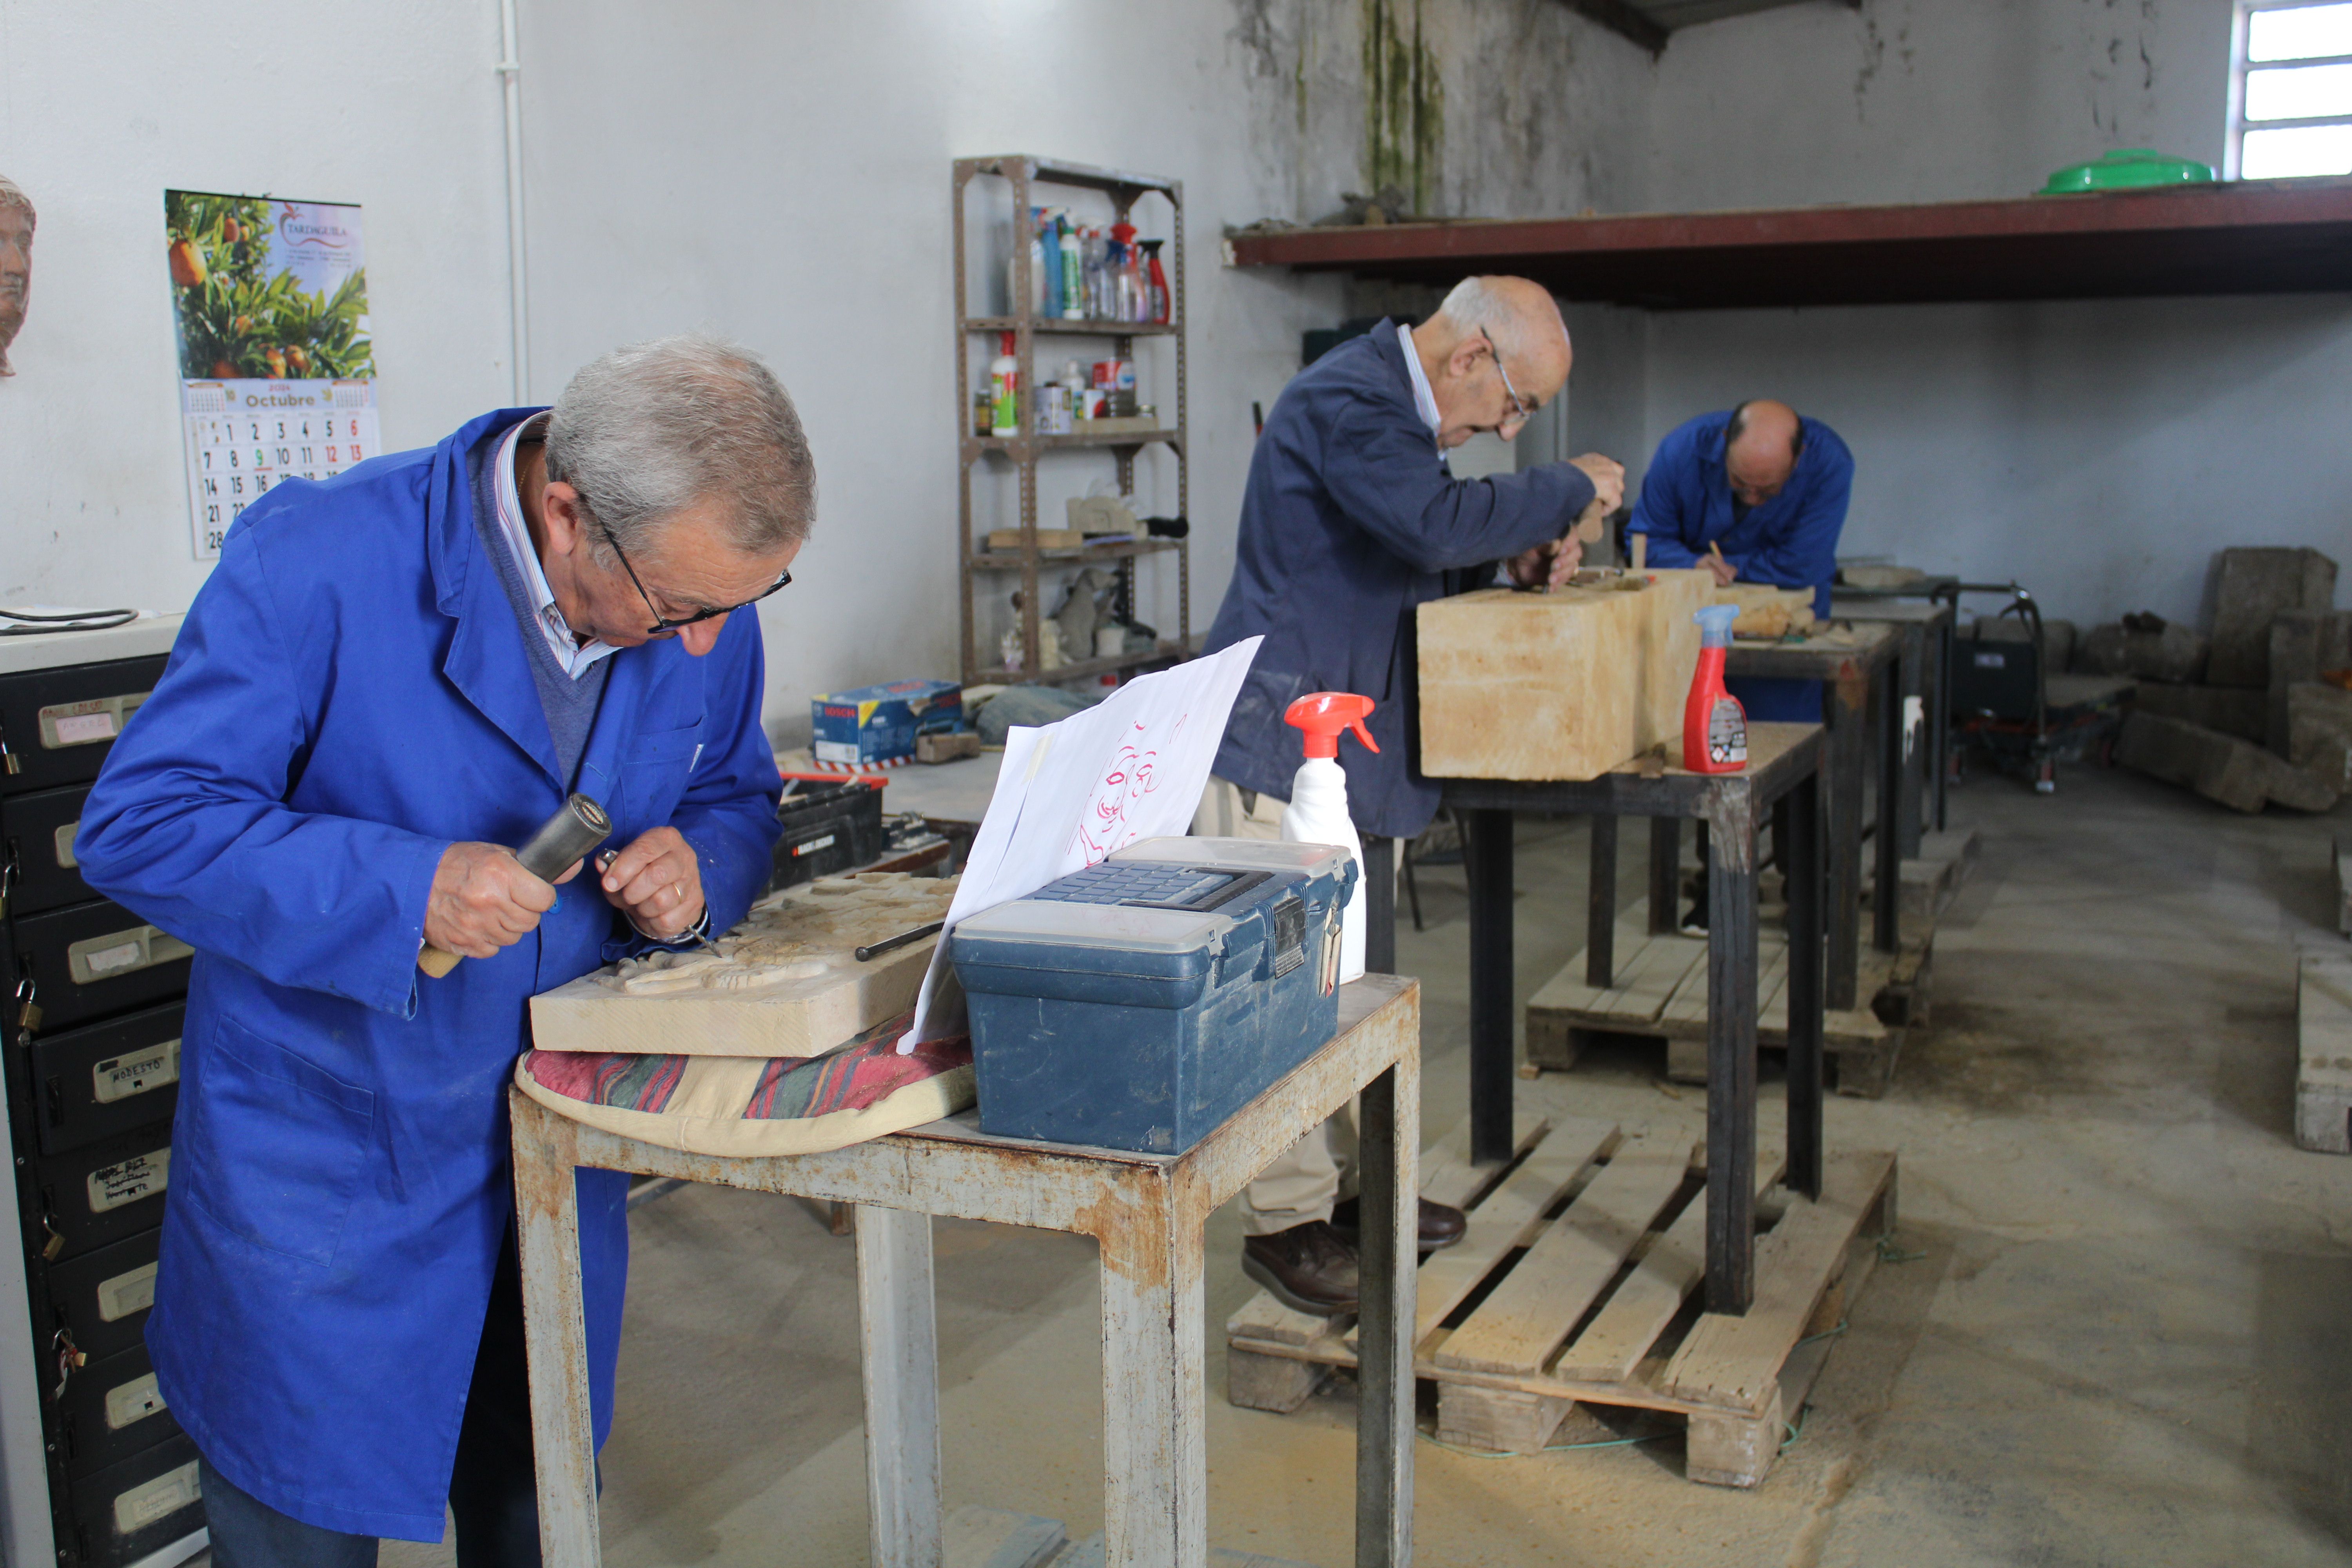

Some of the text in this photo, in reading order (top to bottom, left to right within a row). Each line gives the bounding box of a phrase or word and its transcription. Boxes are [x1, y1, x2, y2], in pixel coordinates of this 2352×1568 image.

[246, 393, 315, 407] Octubre
[226, 419, 358, 441] 1 2 3 4 5 6
[204, 444, 361, 469] 7 8 9 10 11 12 13
[205, 478, 218, 495] 14
[231, 476, 243, 494] 15
[256, 475, 267, 492] 16
[208, 505, 220, 522] 21
[209, 531, 223, 548] 28
[825, 707, 856, 718] BOSCH
[113, 1059, 160, 1083] MODESTO
